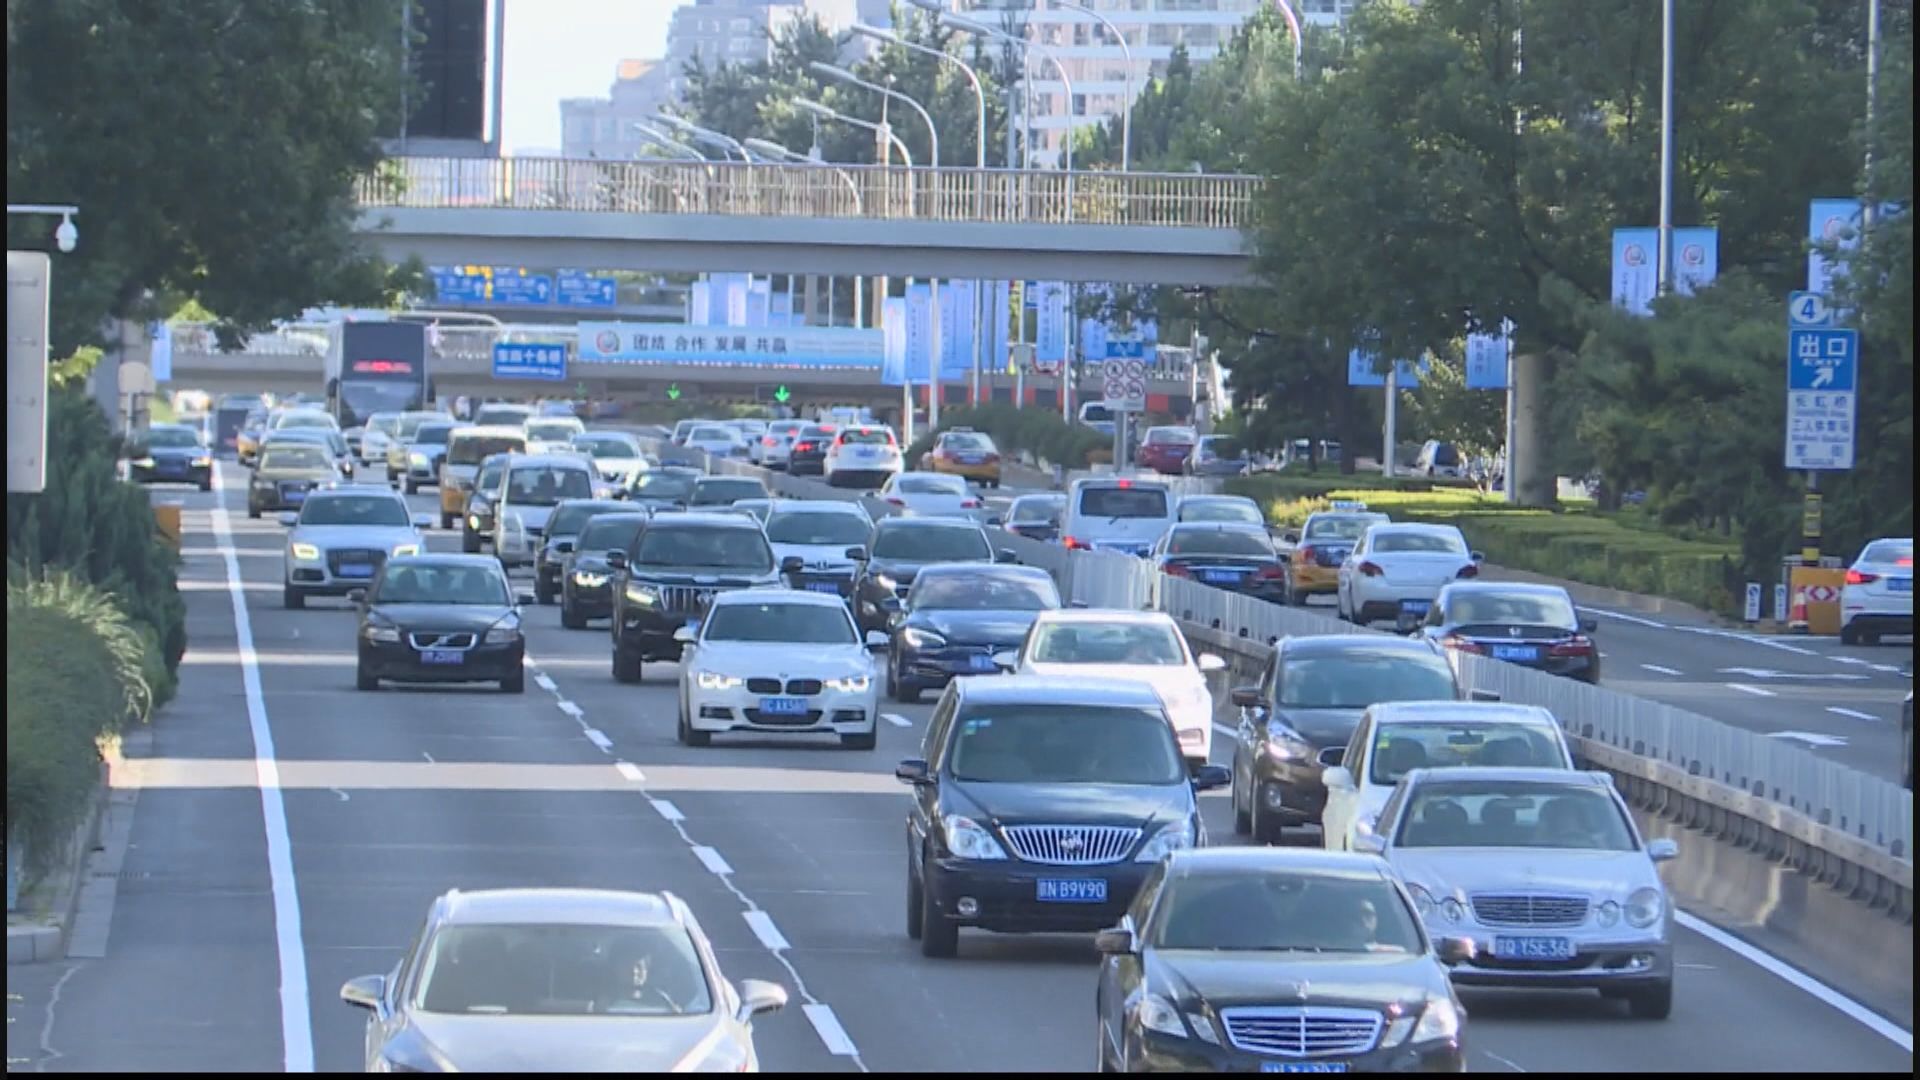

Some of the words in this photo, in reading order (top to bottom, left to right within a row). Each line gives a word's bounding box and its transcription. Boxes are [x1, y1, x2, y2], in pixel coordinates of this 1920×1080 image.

[1801, 298, 1816, 319] 4
[633, 334, 665, 351] 团结
[675, 335, 705, 352] 合作
[715, 336, 746, 352] 发展
[1799, 334, 1848, 357] 出口
